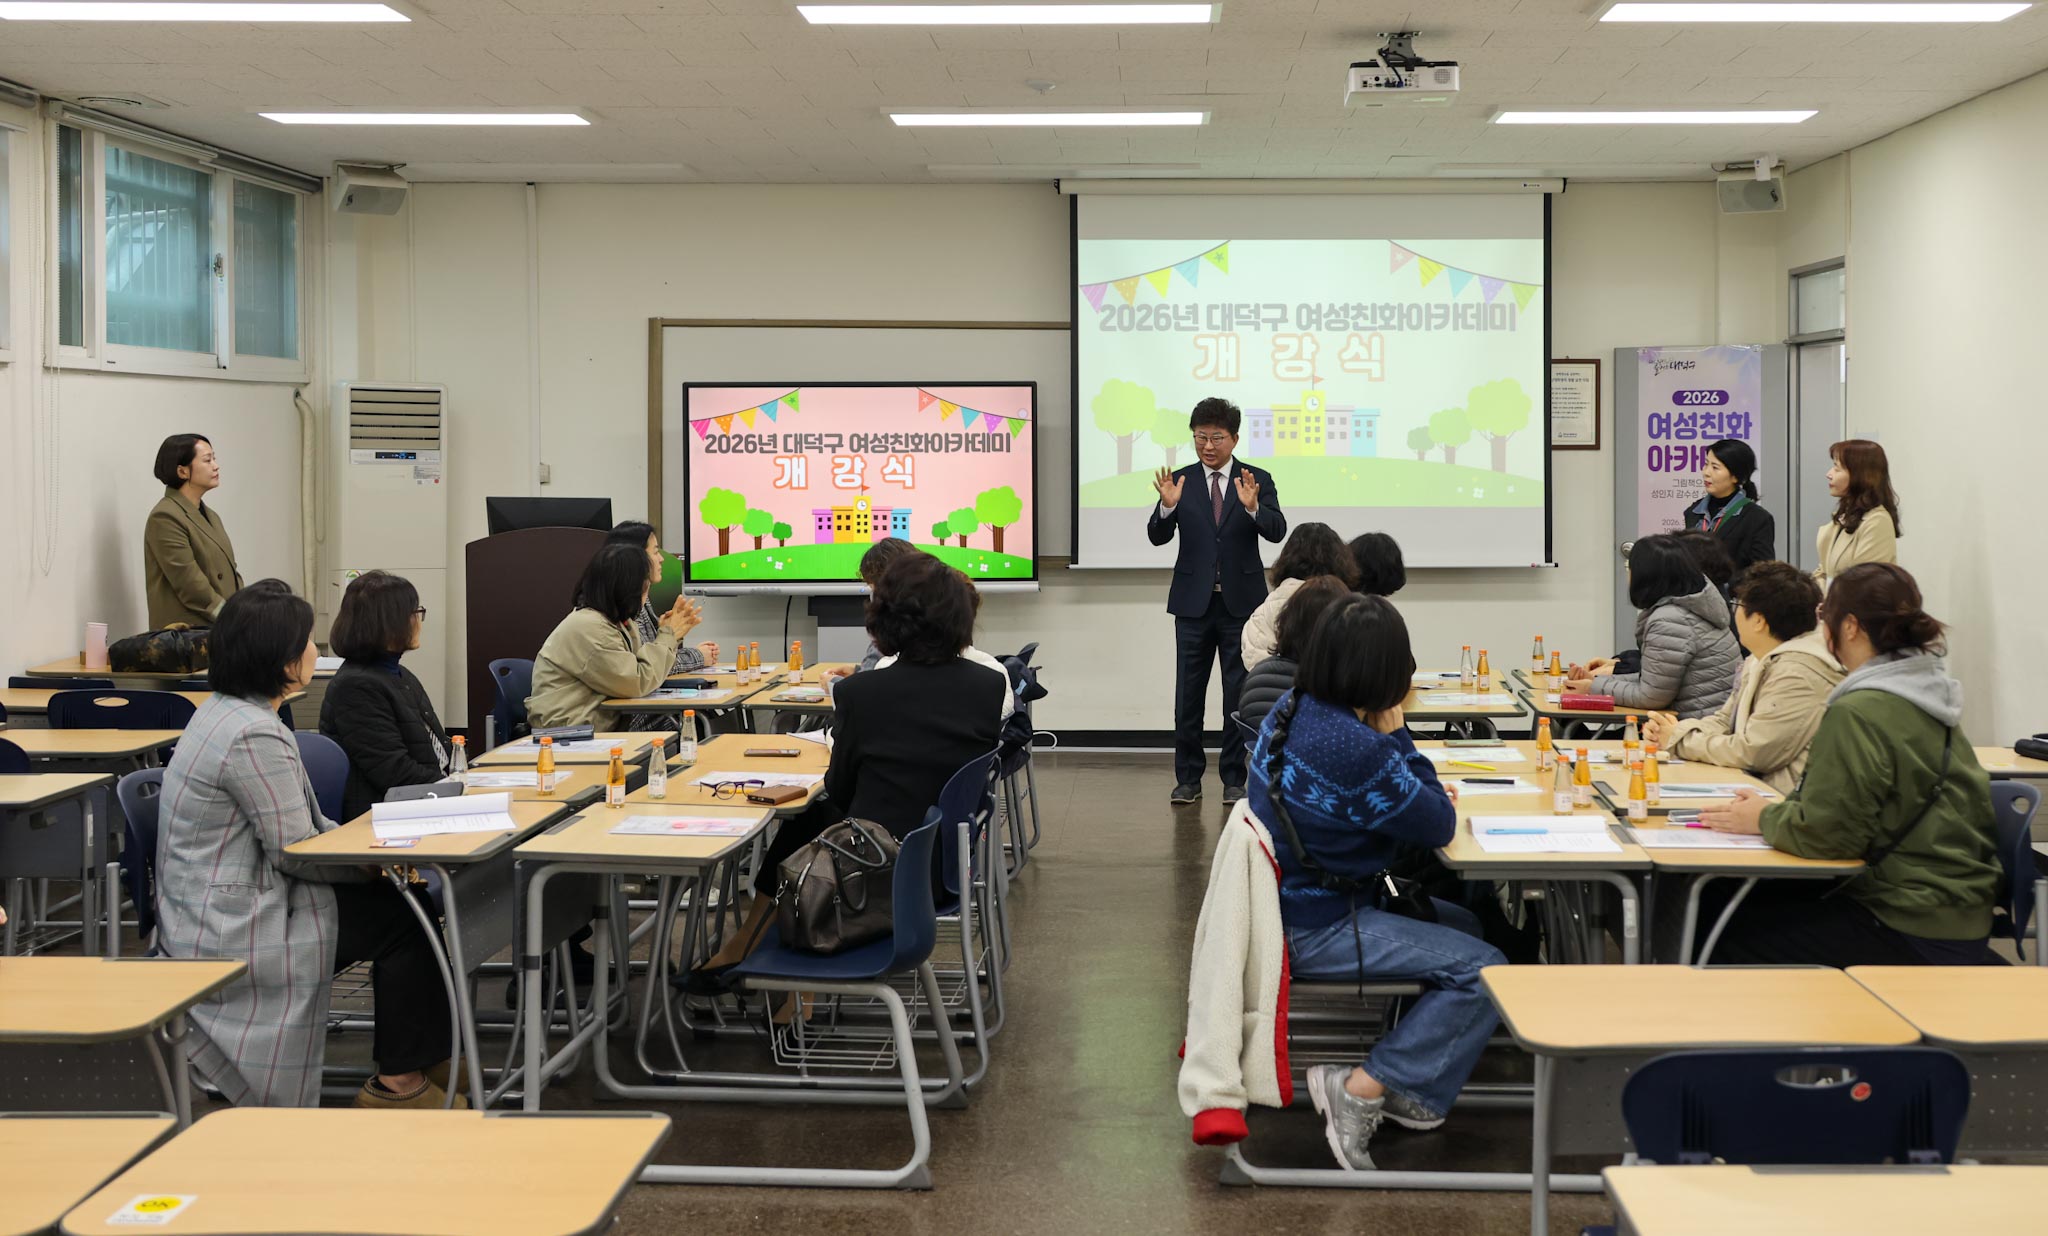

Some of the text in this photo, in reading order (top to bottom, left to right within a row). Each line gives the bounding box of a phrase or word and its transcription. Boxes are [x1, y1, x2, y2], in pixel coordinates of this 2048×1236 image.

[1100, 303, 1516, 332] 2026년 대덕구 여성친화아카데미
[1193, 333, 1384, 381] 개 강 식
[1683, 391, 1720, 404] 2026
[1648, 412, 1753, 440] 여성친화
[705, 433, 1011, 453] 2026년 대덕구 여성친화아카데미
[773, 454, 915, 490] 개 강 식
[1672, 479, 1706, 487] 그림책으
